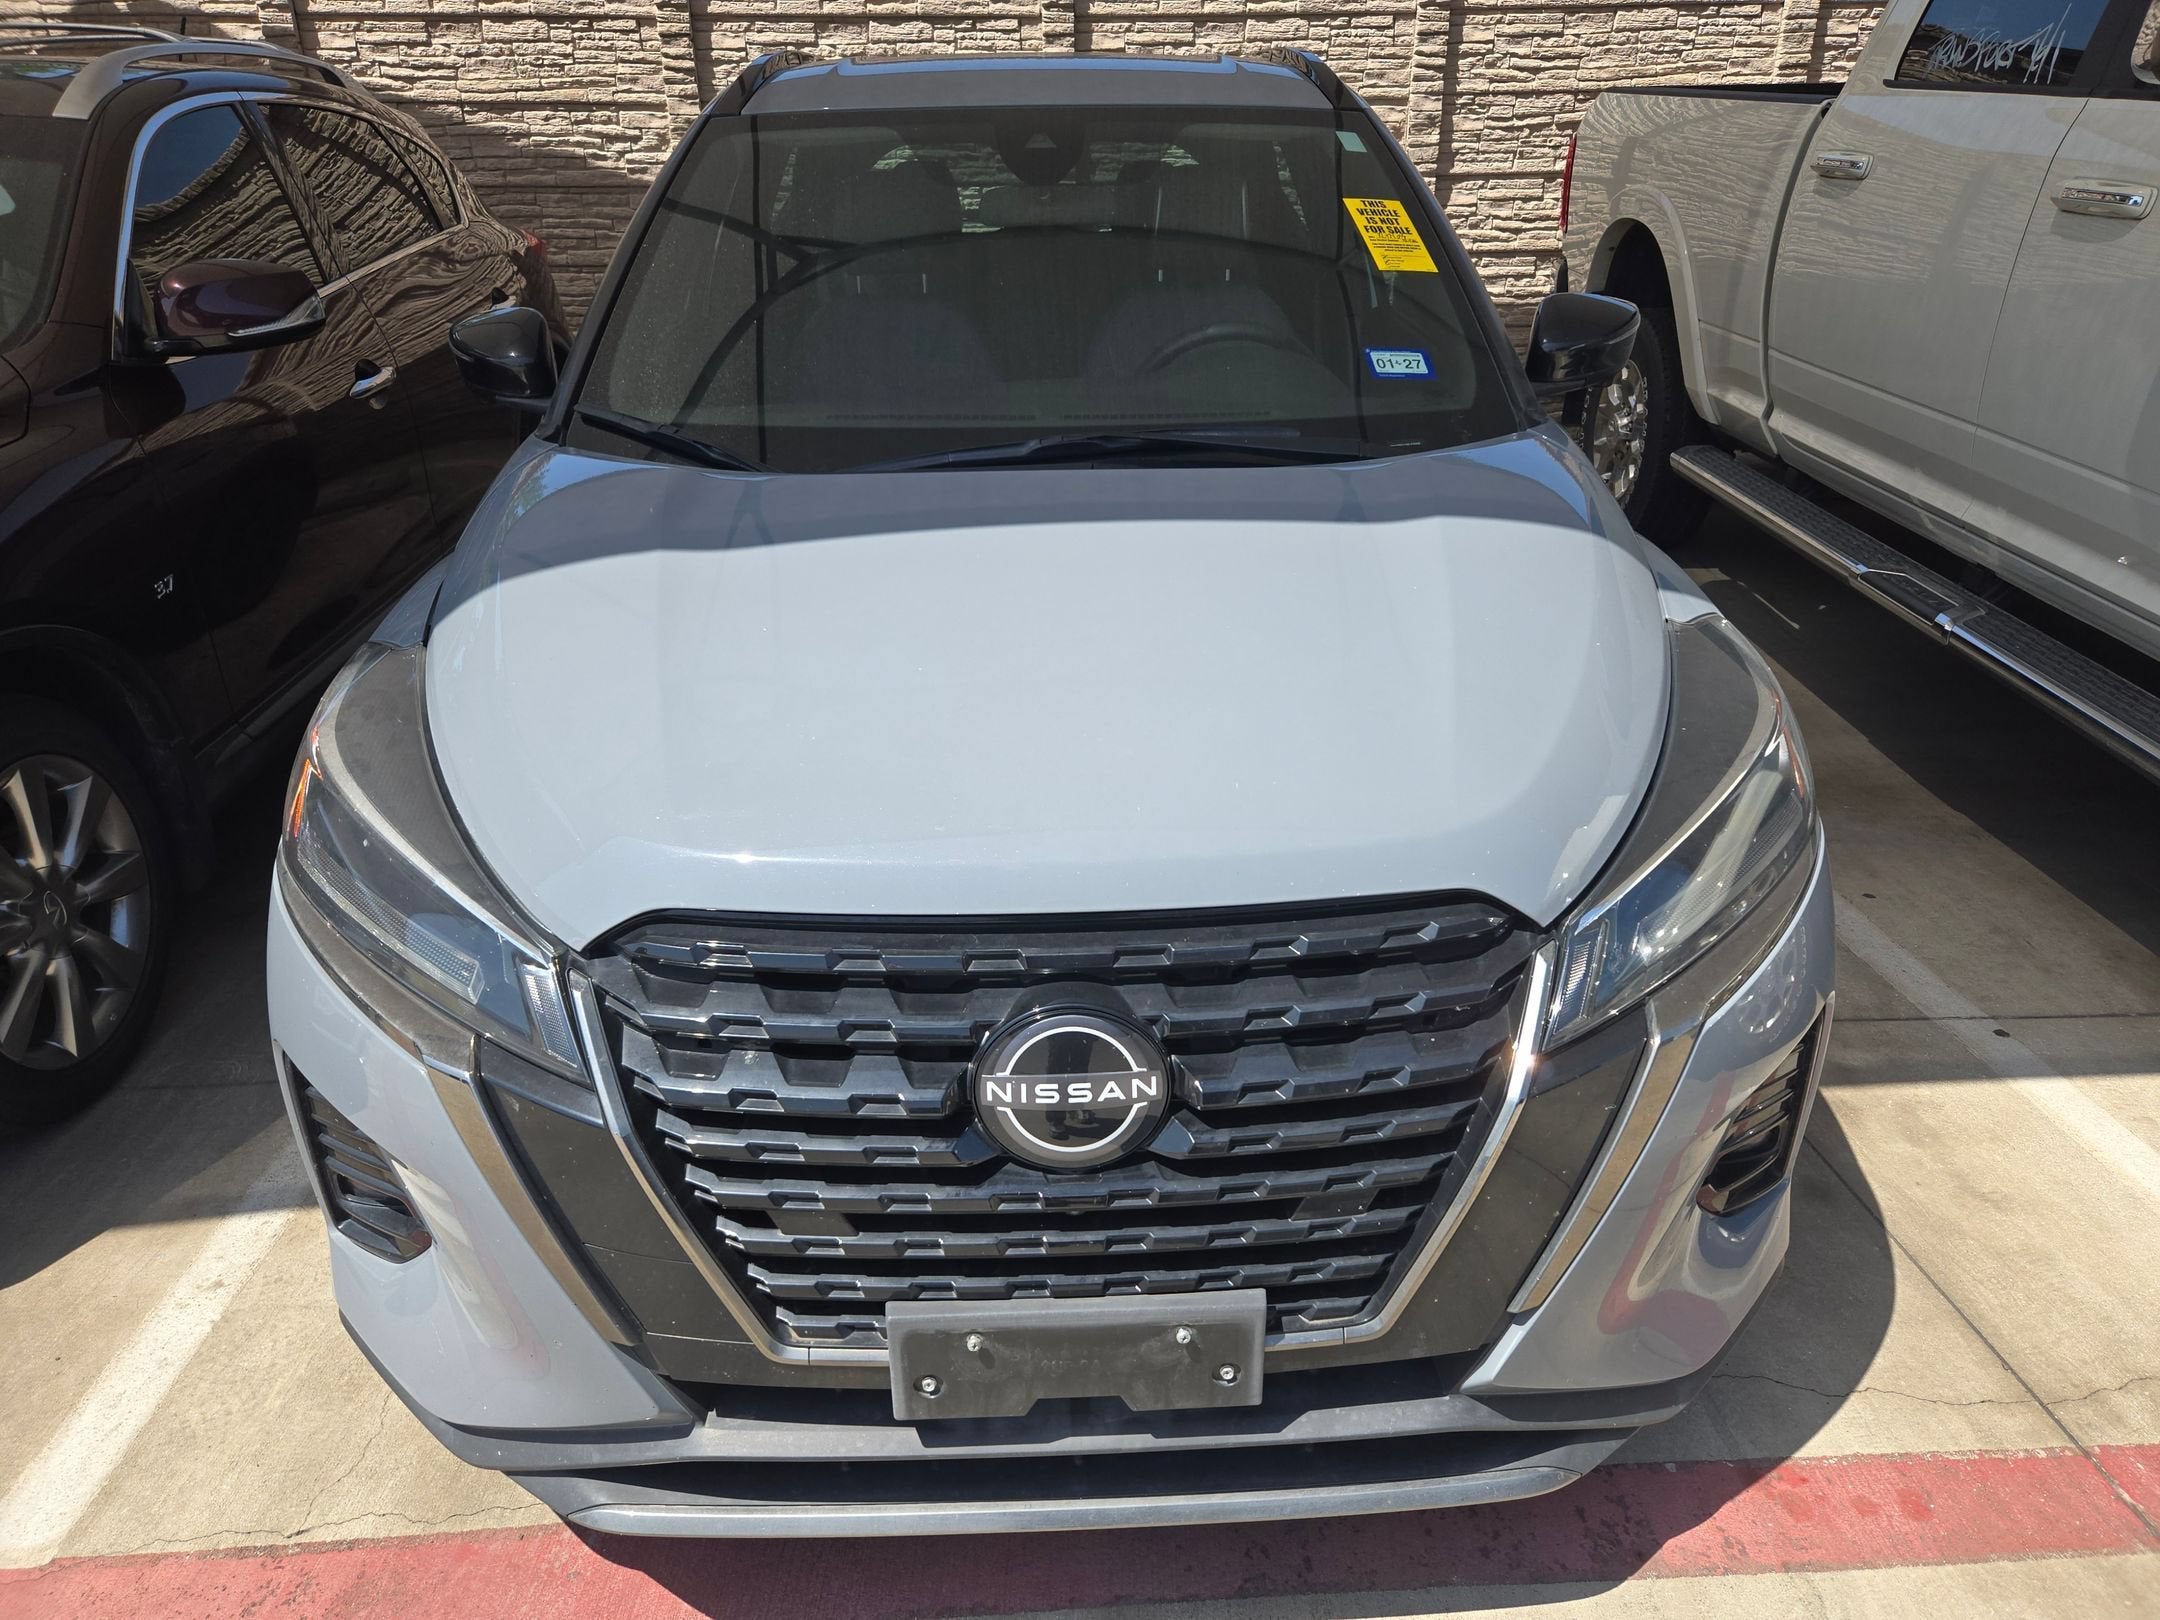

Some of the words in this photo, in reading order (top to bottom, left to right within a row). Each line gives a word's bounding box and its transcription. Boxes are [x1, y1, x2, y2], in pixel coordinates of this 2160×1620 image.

[1360, 200, 1387, 209] THIS
[1356, 208, 1401, 218] VEHICLE
[1365, 216, 1379, 225] IS
[1378, 217, 1400, 226] NOT
[1363, 225, 1386, 233] FOR
[1386, 226, 1413, 235] SALE
[986, 1075, 1157, 1104] NISSAN
